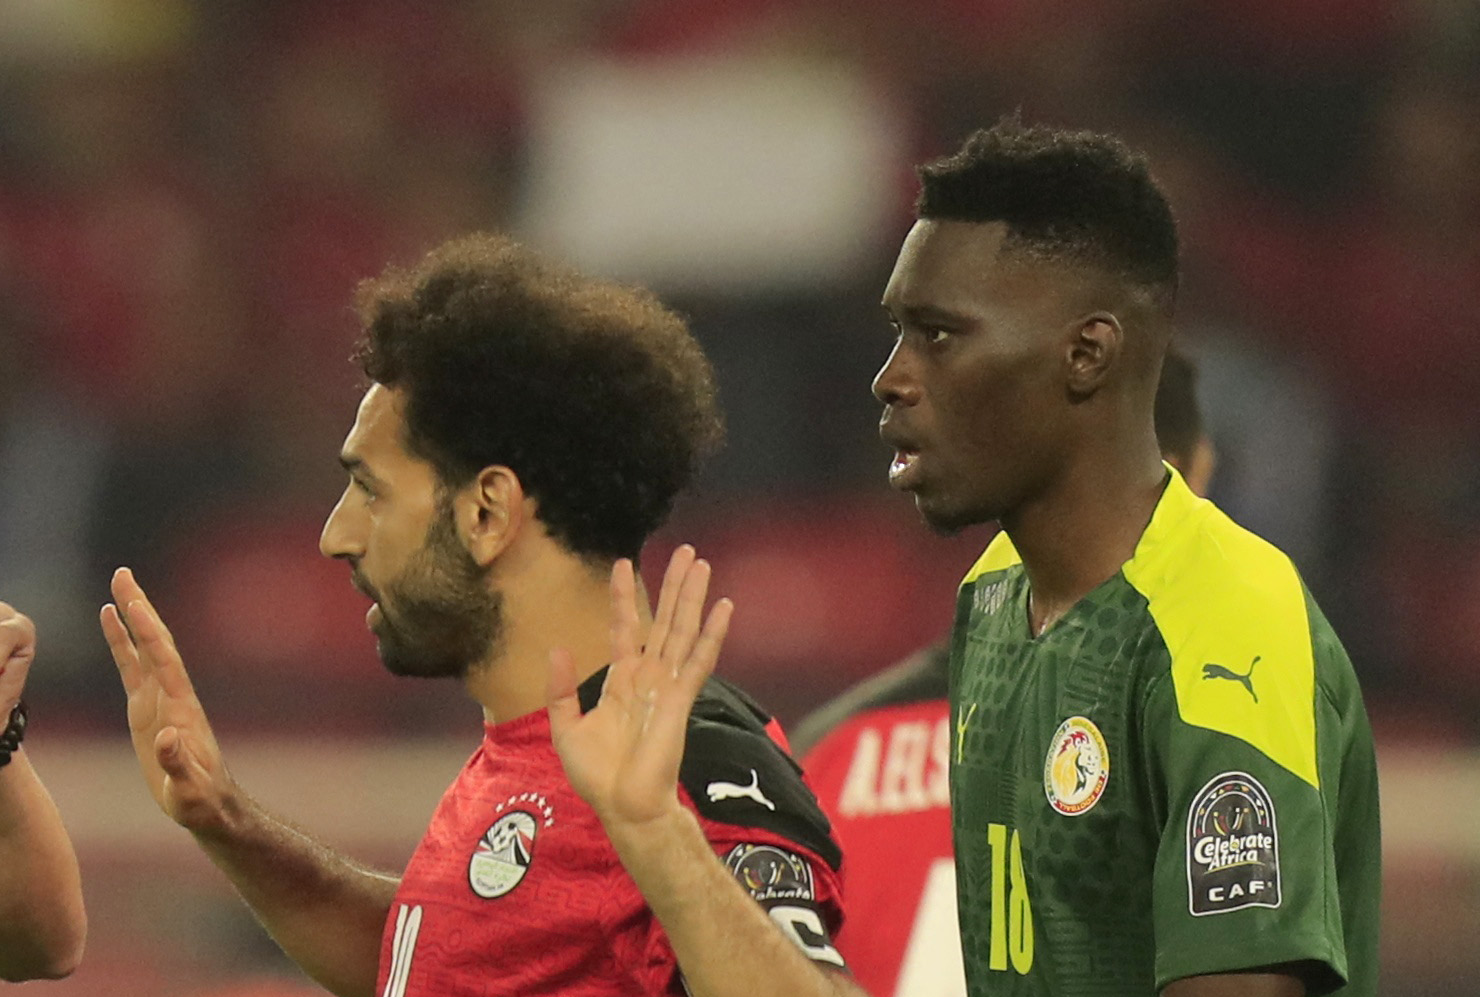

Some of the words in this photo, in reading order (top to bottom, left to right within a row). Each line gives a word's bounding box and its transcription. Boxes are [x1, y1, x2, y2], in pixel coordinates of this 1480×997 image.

[1193, 832, 1273, 865] Celebrate
[1207, 848, 1259, 872] Africa
[987, 822, 1035, 976] 18
[1208, 880, 1266, 902] CAF
[769, 905, 845, 967] C
